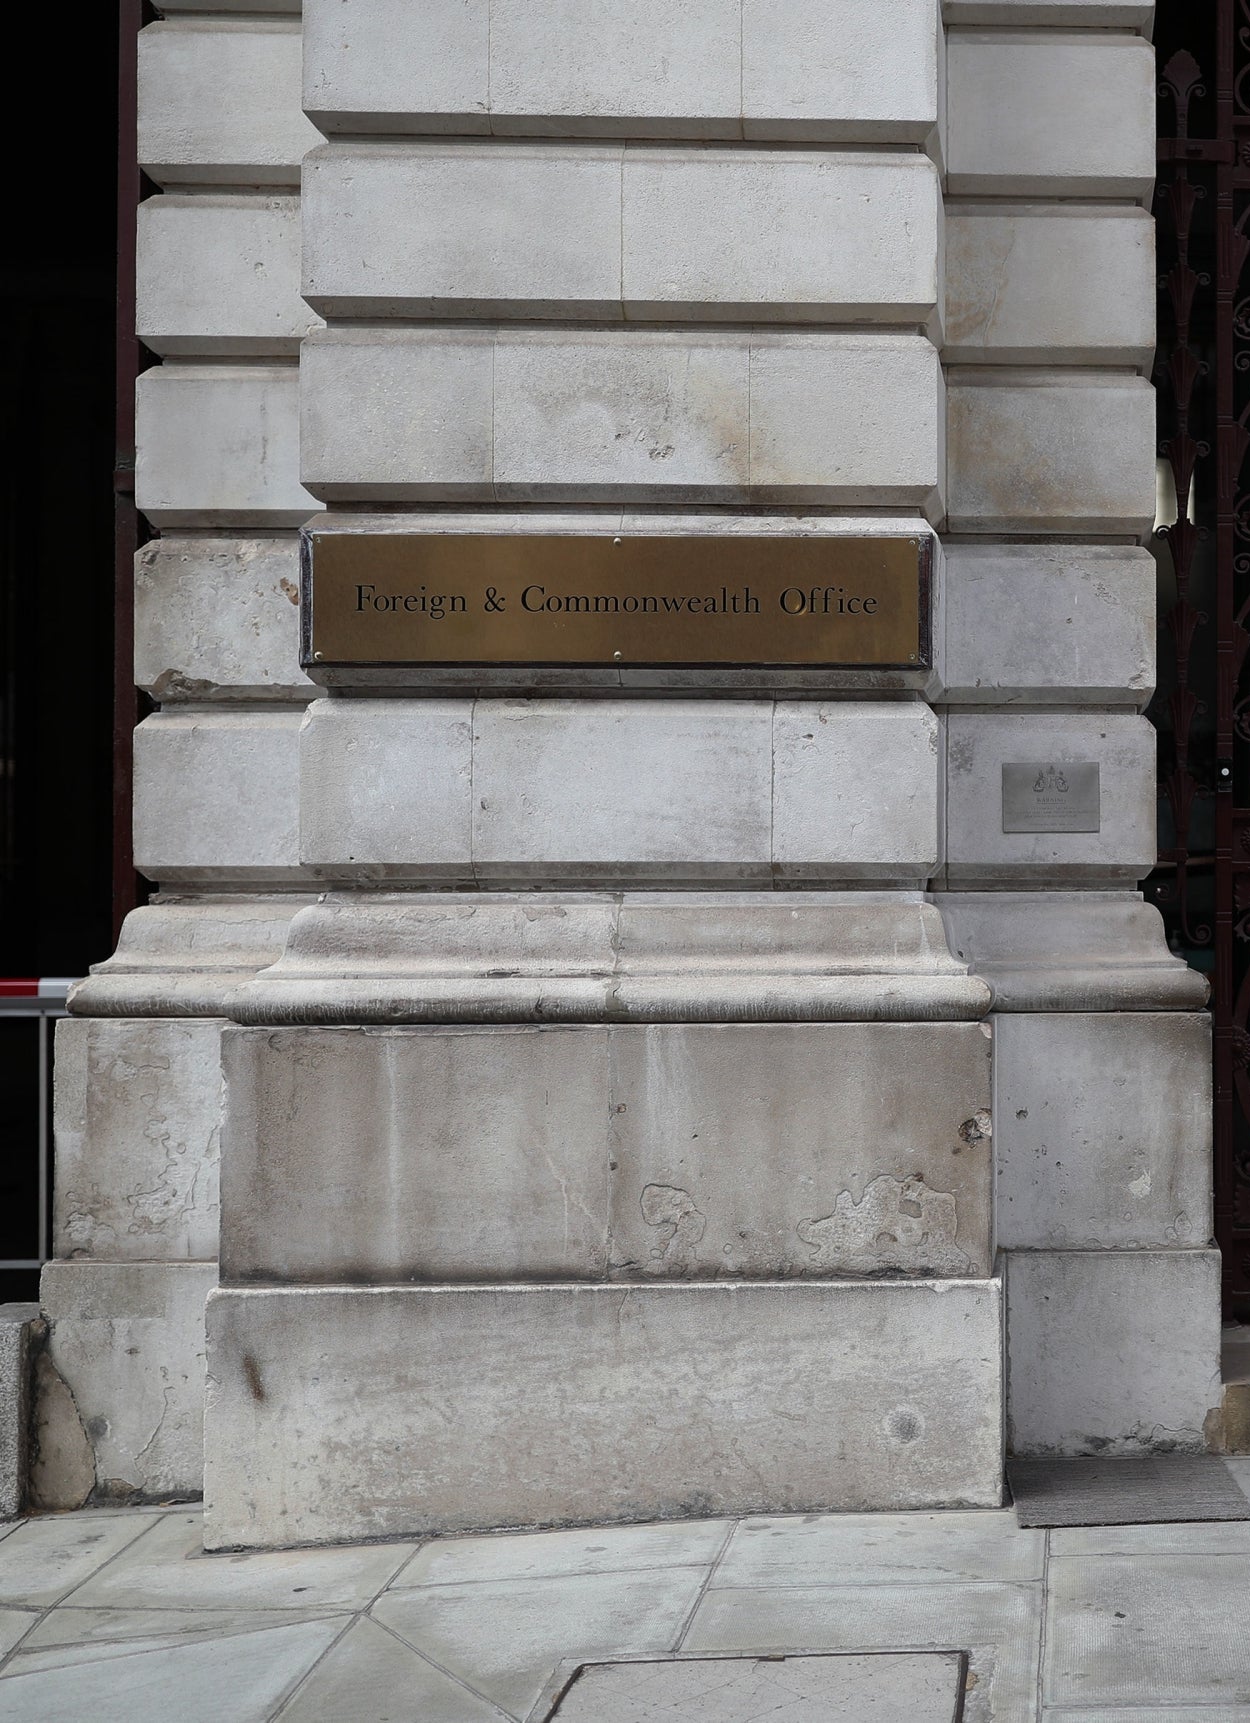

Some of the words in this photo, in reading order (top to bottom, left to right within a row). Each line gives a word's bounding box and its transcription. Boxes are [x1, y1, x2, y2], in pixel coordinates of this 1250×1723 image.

[354, 585, 468, 620] Foreign
[483, 587, 506, 613] &
[520, 585, 761, 616] Commonwealth
[779, 587, 878, 616] Office
